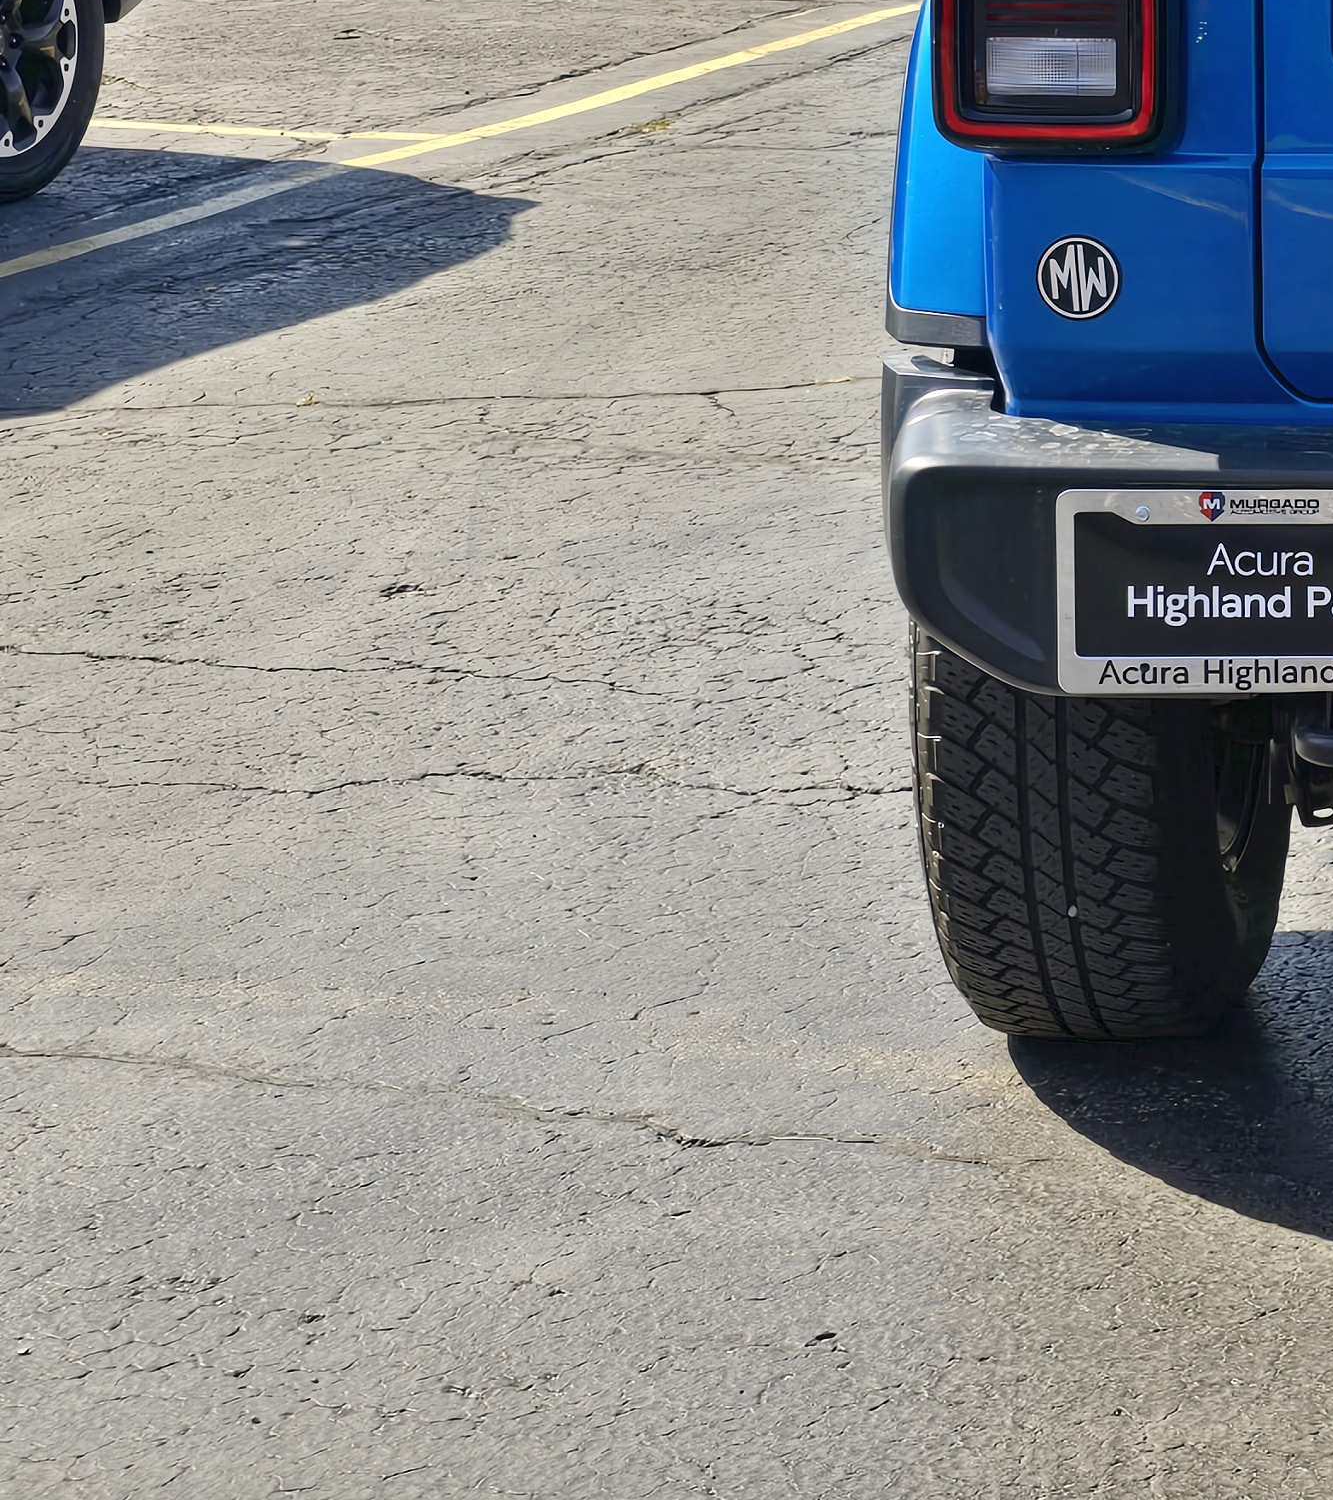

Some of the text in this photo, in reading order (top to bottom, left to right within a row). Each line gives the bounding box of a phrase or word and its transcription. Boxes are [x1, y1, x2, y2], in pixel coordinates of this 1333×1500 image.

[1206, 542, 1315, 577] Acura
[1127, 585, 1293, 627] Highland
[1098, 659, 1190, 686] Acura
